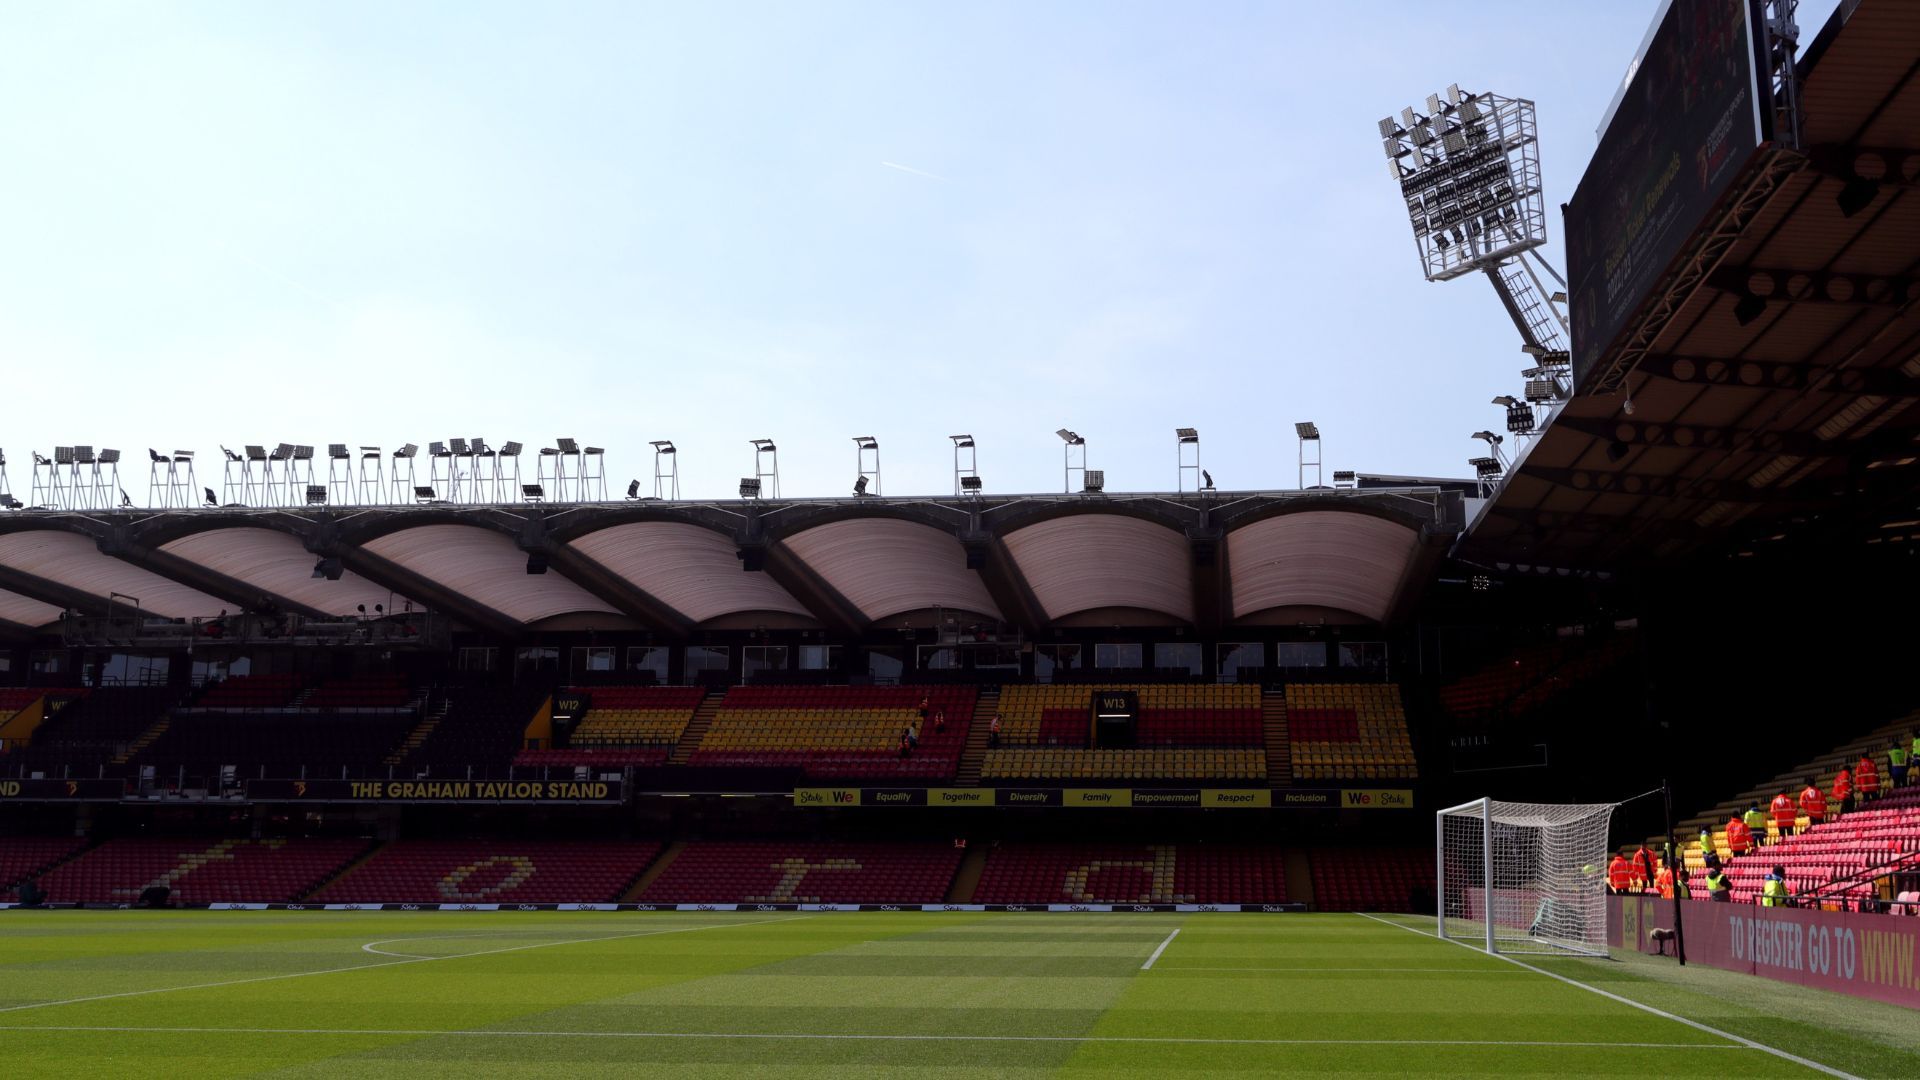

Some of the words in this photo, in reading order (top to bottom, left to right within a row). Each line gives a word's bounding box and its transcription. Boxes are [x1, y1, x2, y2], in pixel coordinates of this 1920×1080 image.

[558, 699, 580, 711] W12
[1104, 697, 1126, 710] W13
[351, 782, 382, 799] THE
[387, 781, 470, 799] GRAHAM
[475, 782, 543, 799] TAYLOR
[548, 782, 608, 799] STAND
[832, 791, 854, 803] We
[876, 792, 912, 803] Equality
[941, 792, 981, 803] Together
[1009, 792, 1048, 804] Diversity
[1082, 792, 1112, 804] Family
[1133, 793, 1199, 803] Empowerment
[1216, 793, 1255, 804] Respect
[1285, 793, 1327, 803] Inclusion
[1347, 792, 1371, 804] We
[1730, 916, 1744, 959] TO
[1747, 918, 1803, 970] REGISTER
[1808, 924, 1830, 975] GO
[1835, 927, 1855, 980] TO
